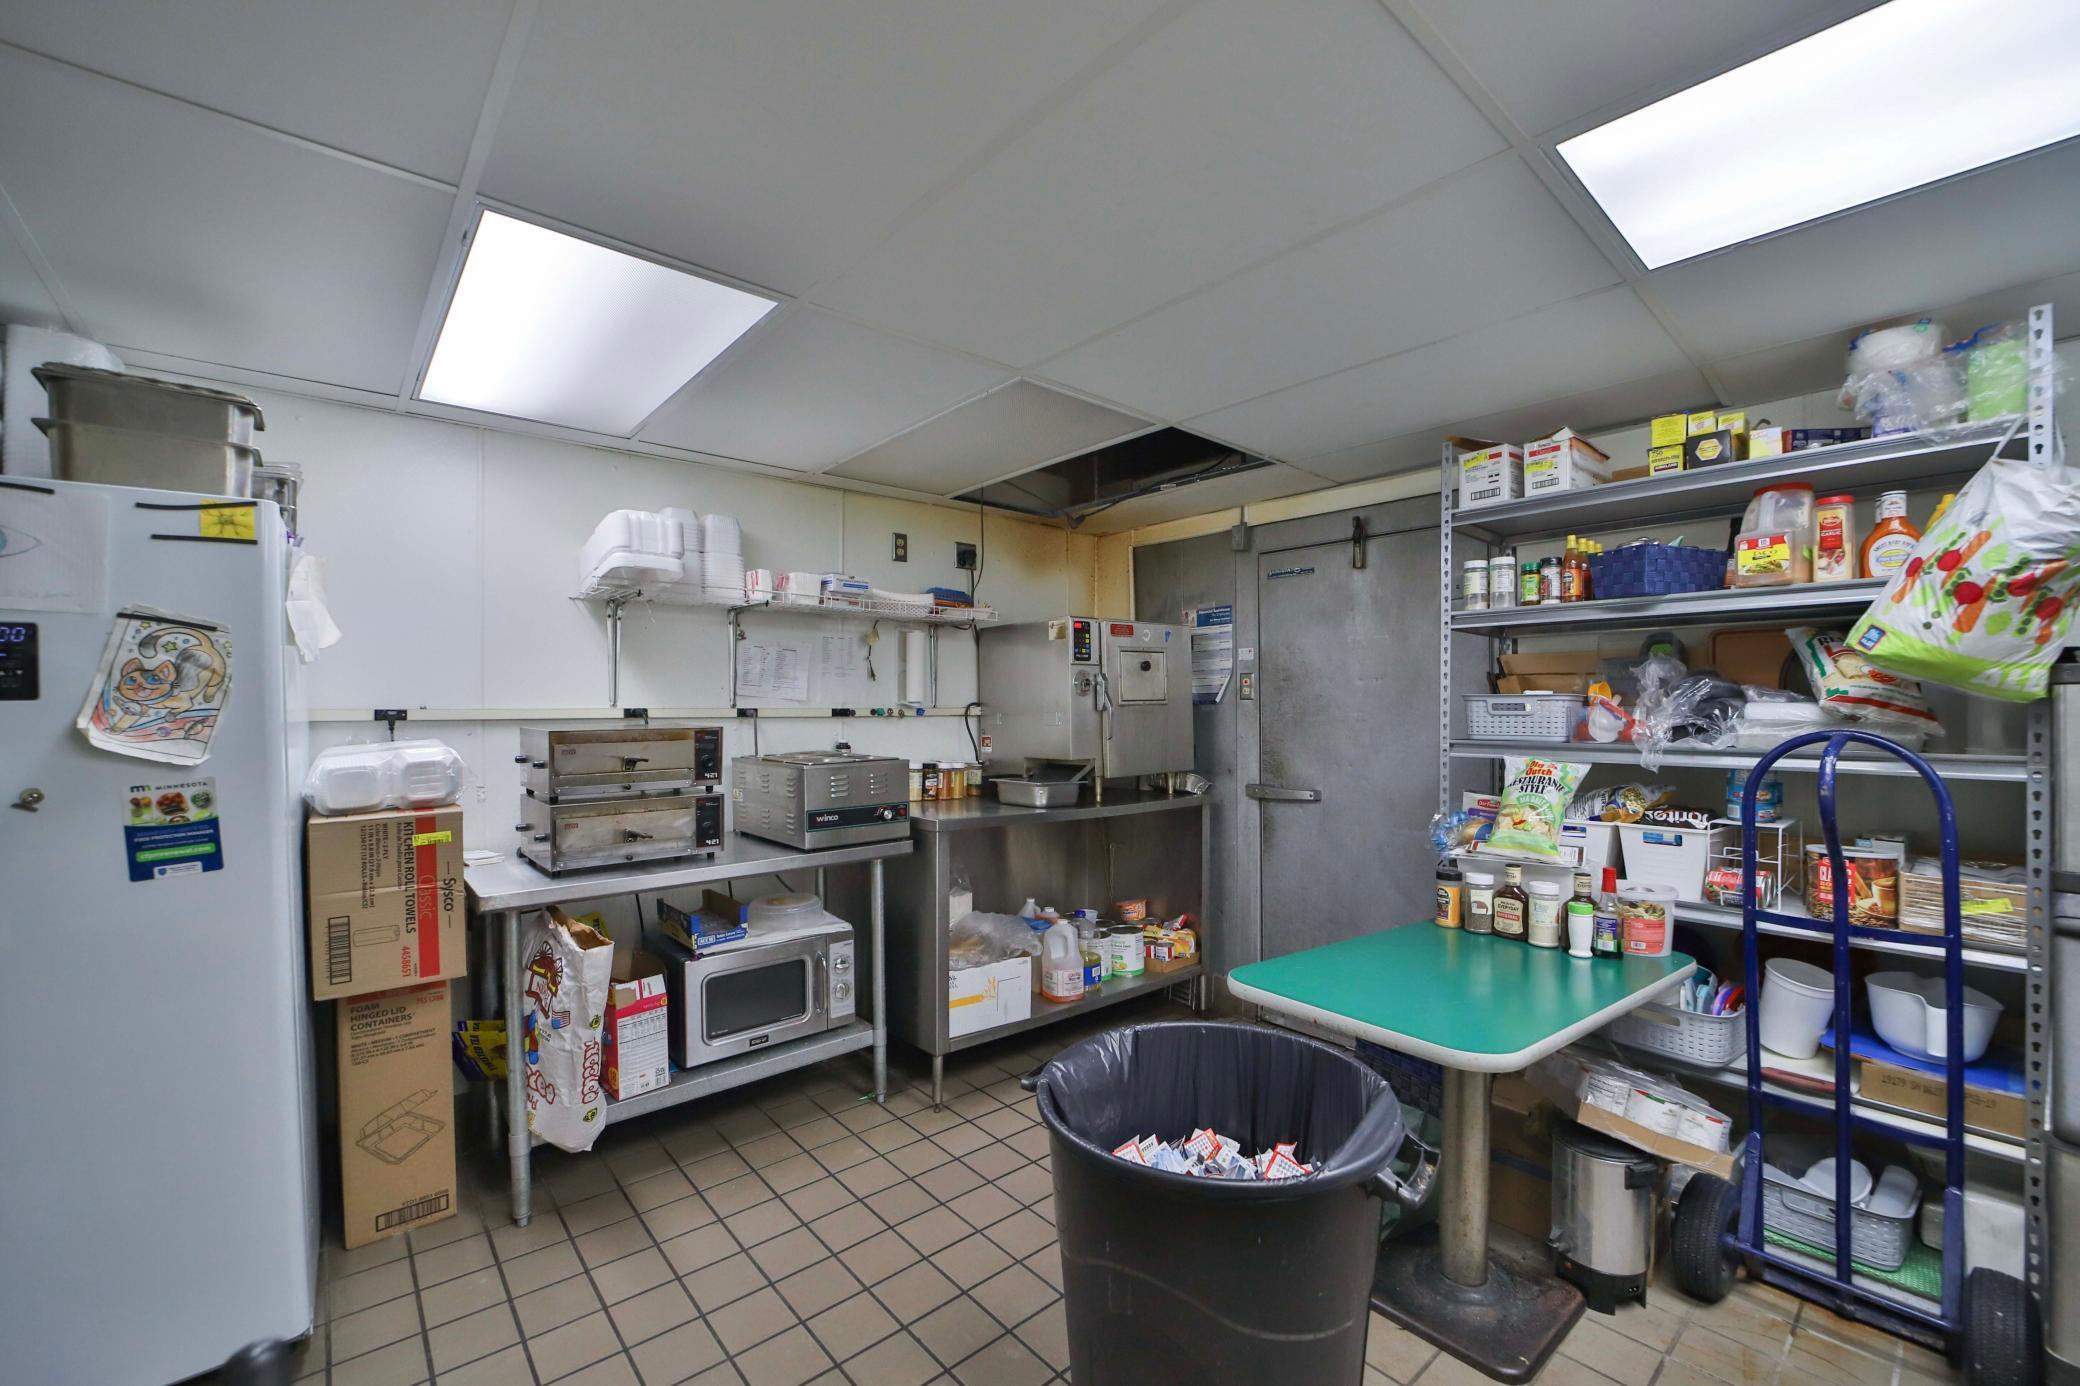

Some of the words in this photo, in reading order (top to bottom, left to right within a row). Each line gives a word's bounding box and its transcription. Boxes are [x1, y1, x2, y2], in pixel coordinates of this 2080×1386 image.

[155, 782, 208, 790] MINNESOTA
[1519, 784, 1546, 794] STYLE
[403, 822, 415, 866] KITCHEN
[404, 867, 414, 891] ROLL
[419, 875, 435, 919] Classic
[442, 878, 456, 912] Sysco
[405, 895, 416, 934] TOWELS
[350, 1003, 379, 1014] FOAM
[350, 1010, 389, 1023] HINGED
[391, 1006, 406, 1014] LID
[350, 1013, 412, 1031] CONTAINERS
